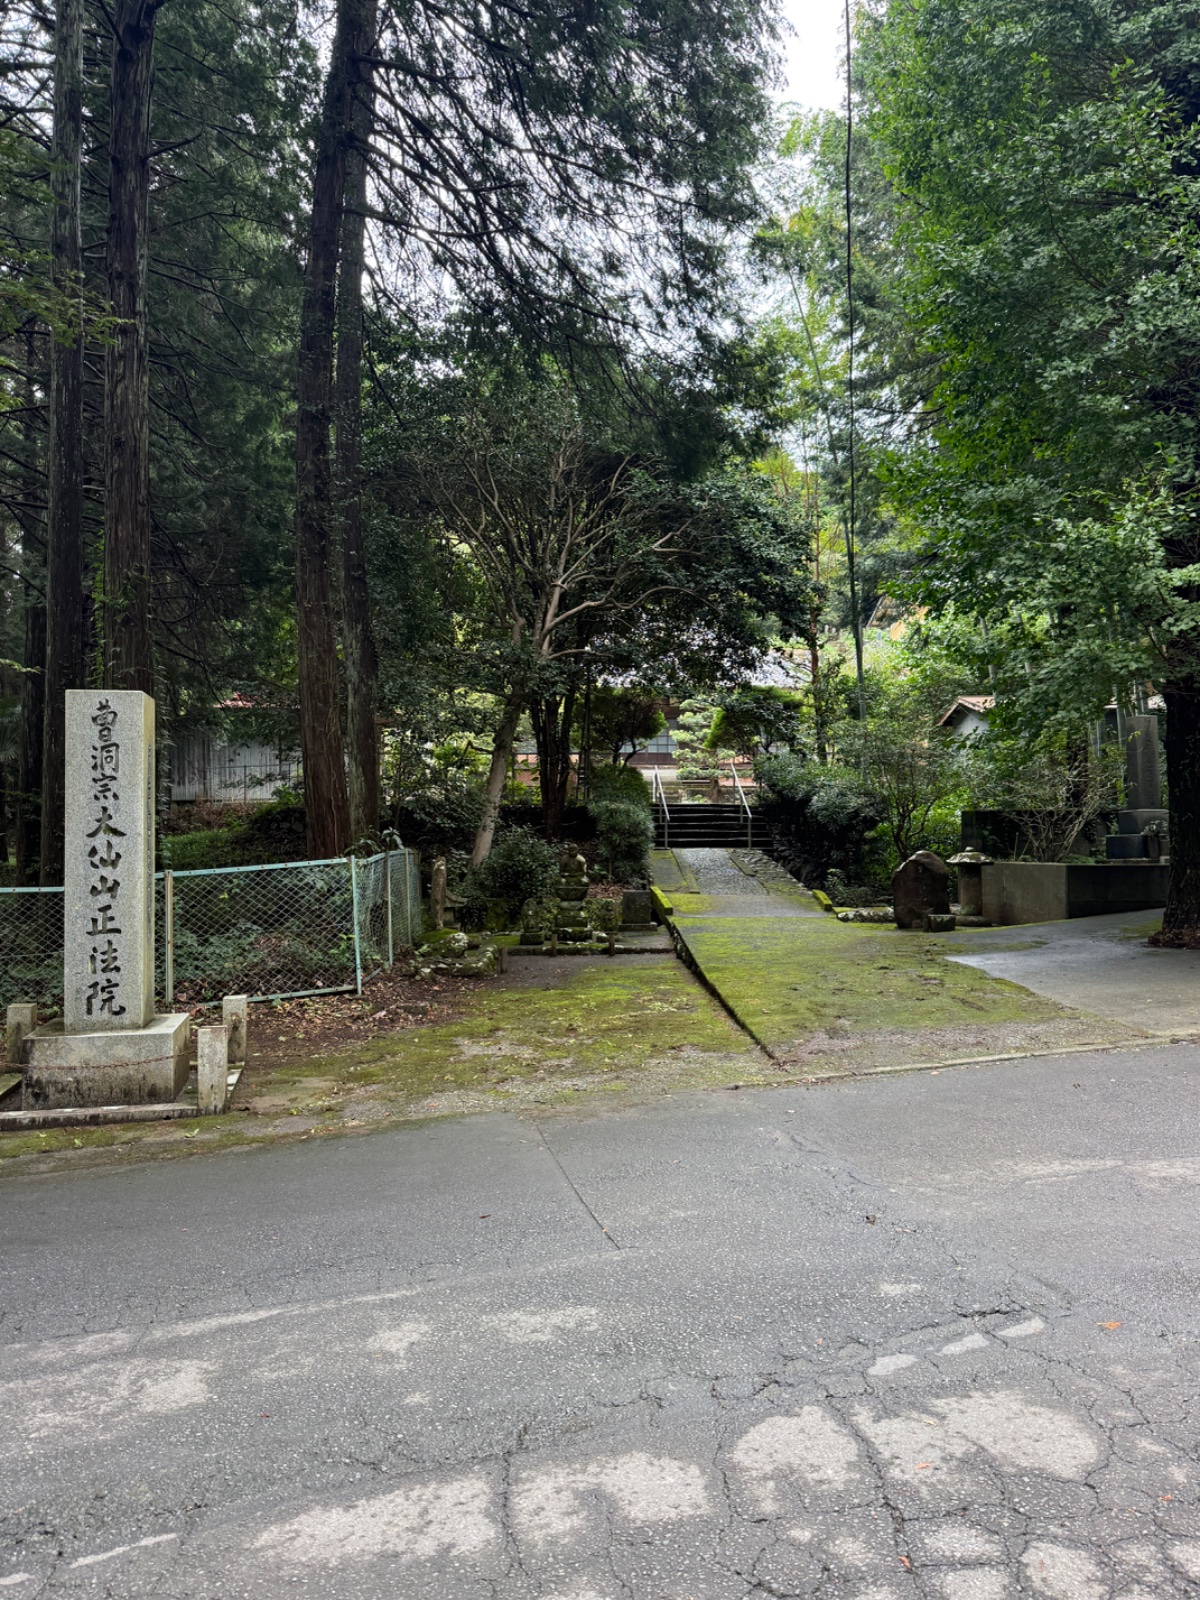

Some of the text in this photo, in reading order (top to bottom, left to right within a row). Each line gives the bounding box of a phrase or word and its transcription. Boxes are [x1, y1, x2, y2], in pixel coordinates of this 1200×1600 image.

[86, 698, 127, 1016] 曹洞宗大仙山正法院
